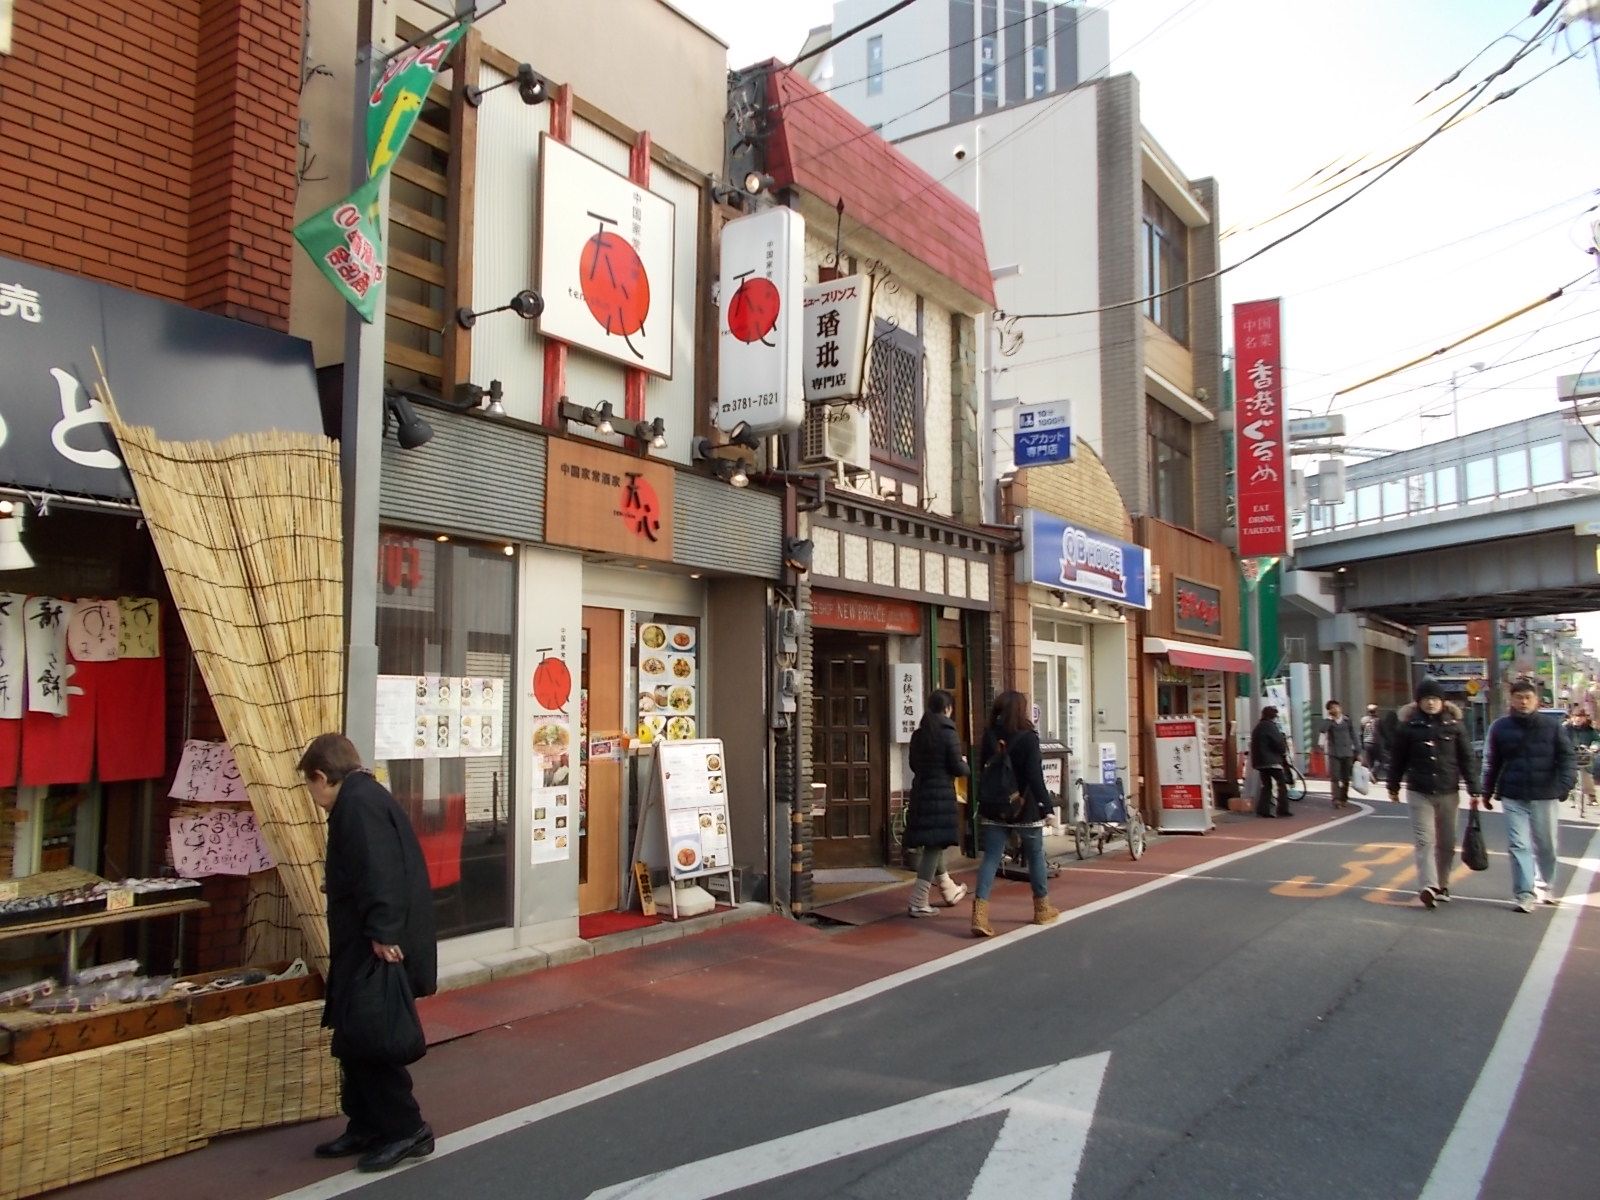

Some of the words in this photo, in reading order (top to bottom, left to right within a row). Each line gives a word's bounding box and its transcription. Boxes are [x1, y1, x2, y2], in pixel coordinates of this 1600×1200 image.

[803, 286, 858, 307] ニュープリンス
[1242, 316, 1272, 332] 中国
[811, 373, 847, 390] 専門店
[731, 392, 779, 412] 3781-7621
[1243, 358, 1278, 486] 香港ぐるめ
[1019, 432, 1064, 445] ヘアカット
[1026, 443, 1058, 458] 専門店
[1253, 504, 1270, 513] EAT
[1248, 515, 1275, 524] DRINK
[1243, 525, 1281, 535] TAKEOUT
[1087, 540, 1121, 574] HOUSE
[837, 602, 856, 620] NEW
[858, 604, 886, 622] PRINCE
[903, 673, 914, 716] お休み処
